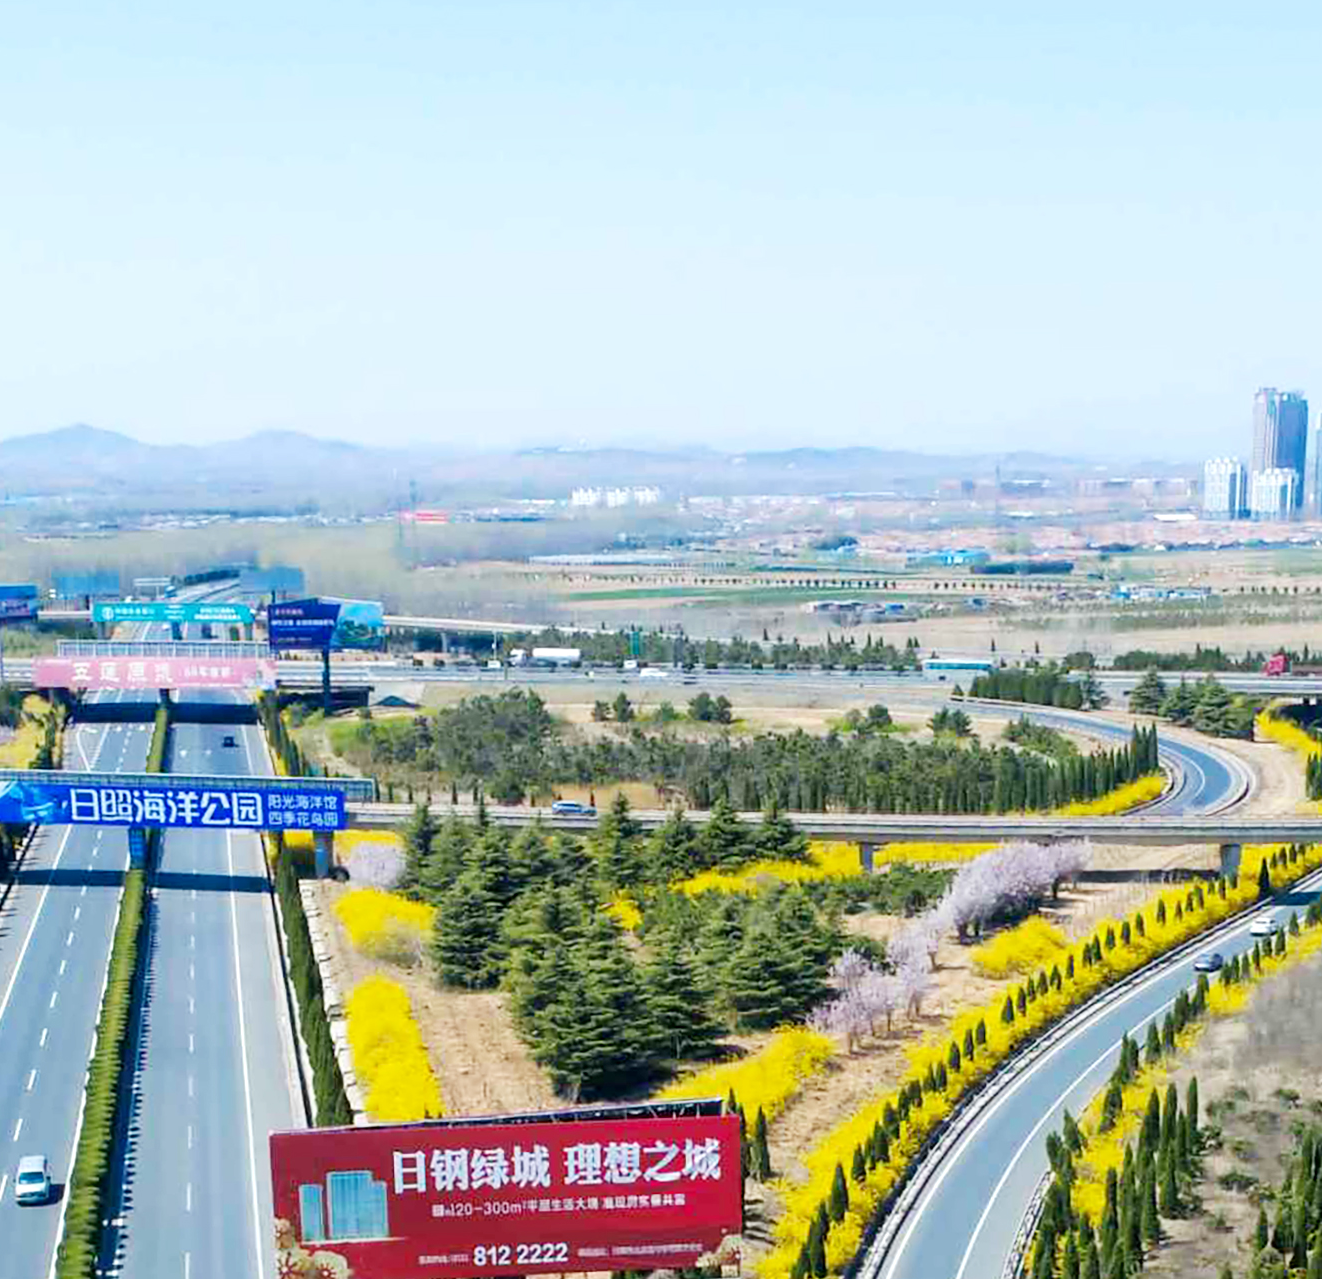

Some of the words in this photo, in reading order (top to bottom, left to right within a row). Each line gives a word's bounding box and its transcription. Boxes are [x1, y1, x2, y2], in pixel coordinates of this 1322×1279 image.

[70, 788, 263, 826] 日照海洋公园
[267, 794, 338, 810] 阳光海洋馆
[392, 1145, 551, 1194] 日钢绿城
[563, 1138, 721, 1185] 理想之城
[473, 1244, 511, 1266] 812
[516, 1242, 568, 1264] 2222
